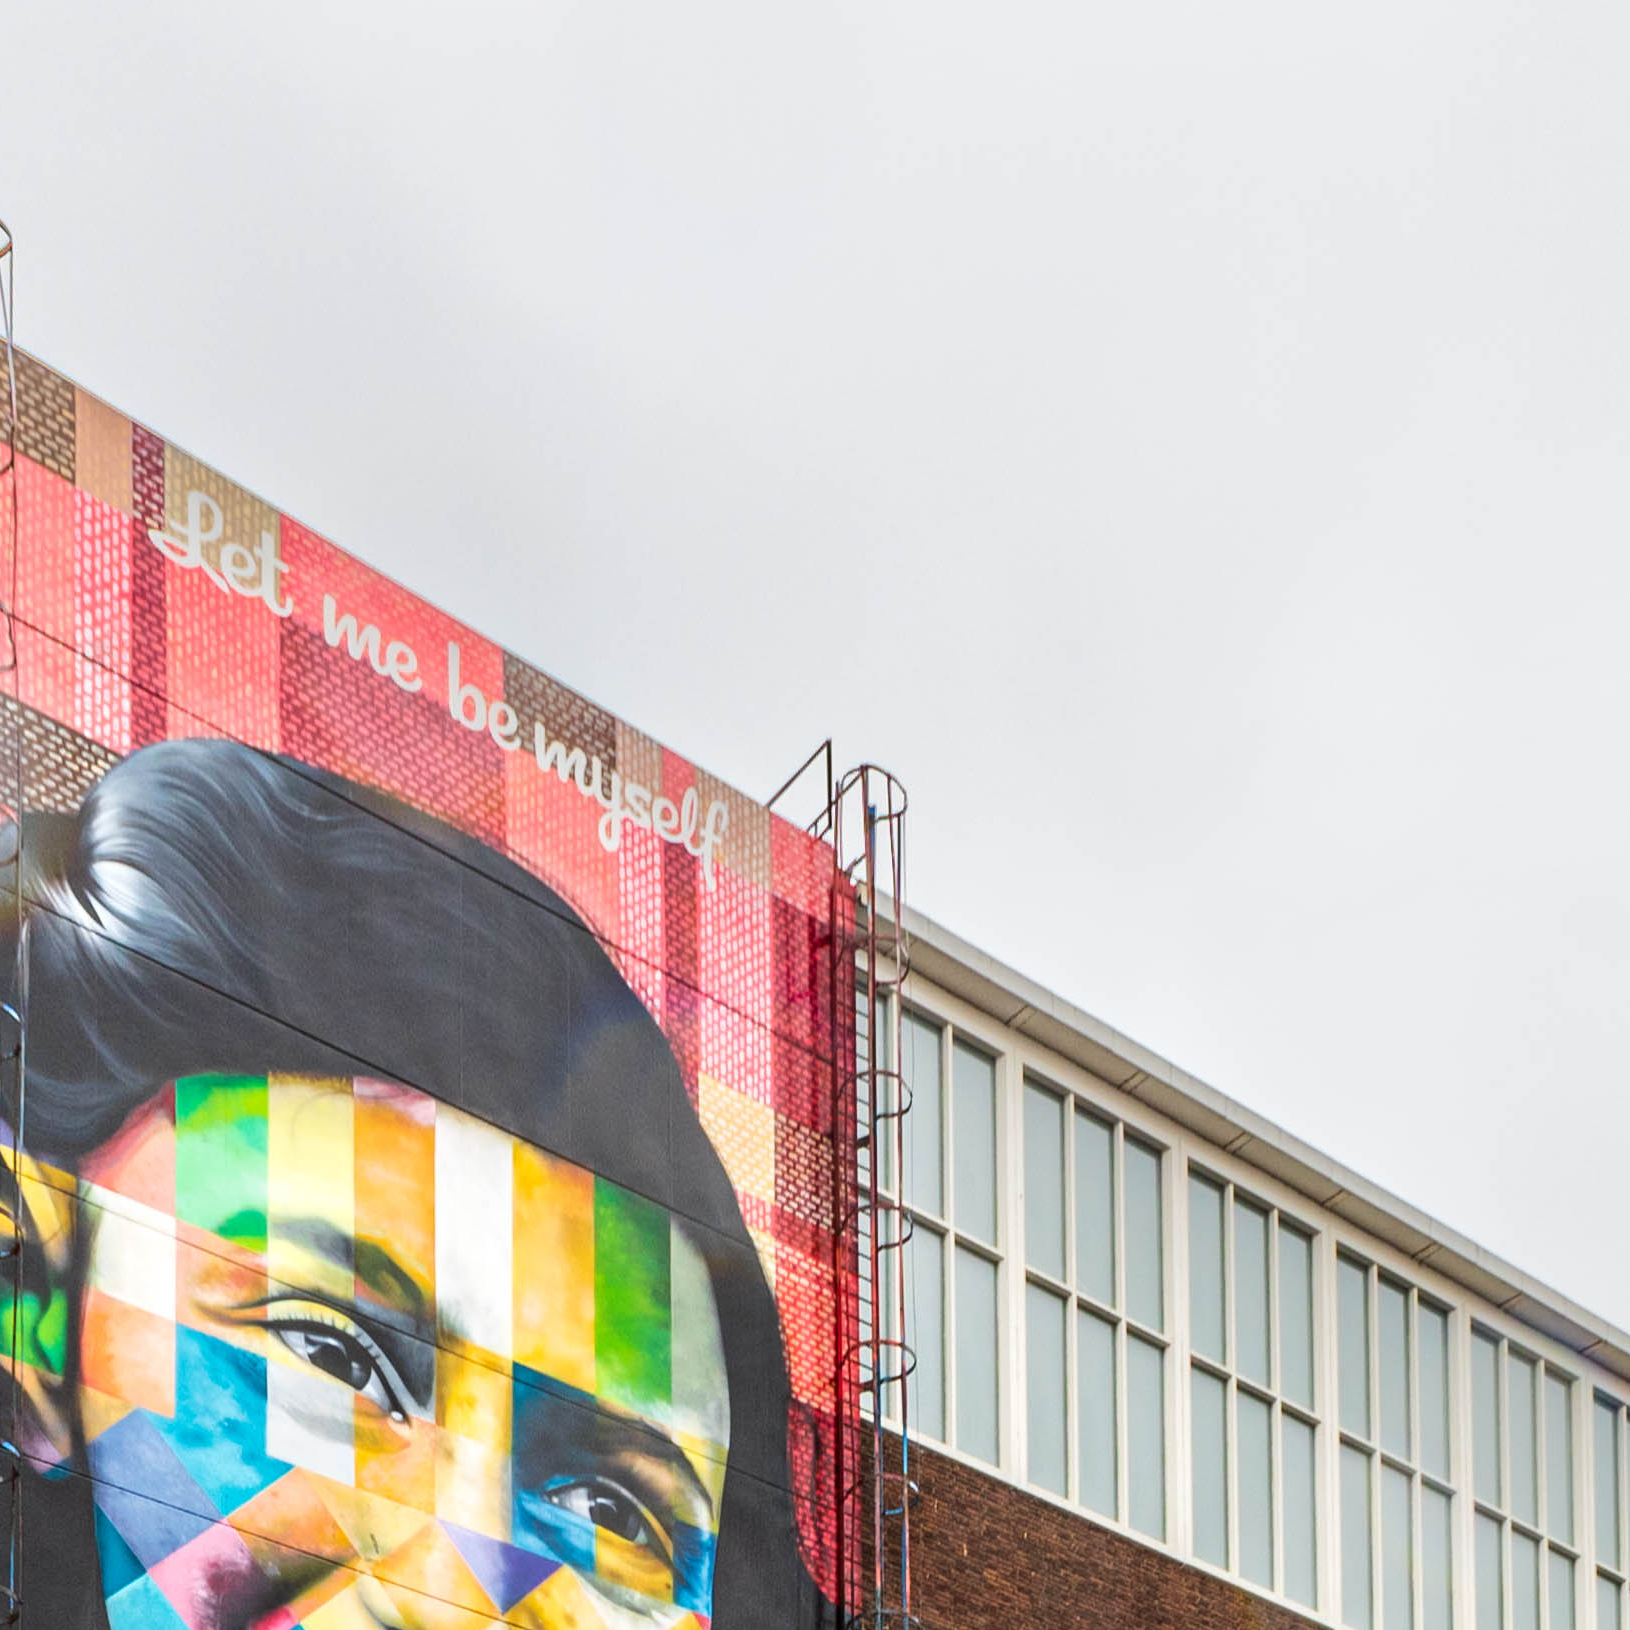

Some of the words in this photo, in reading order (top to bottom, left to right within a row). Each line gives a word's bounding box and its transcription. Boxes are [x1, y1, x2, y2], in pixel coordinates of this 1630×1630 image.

[148, 490, 292, 617] Let
[323, 594, 422, 692] me
[447, 641, 521, 752] be
[534, 721, 730, 892] myself
